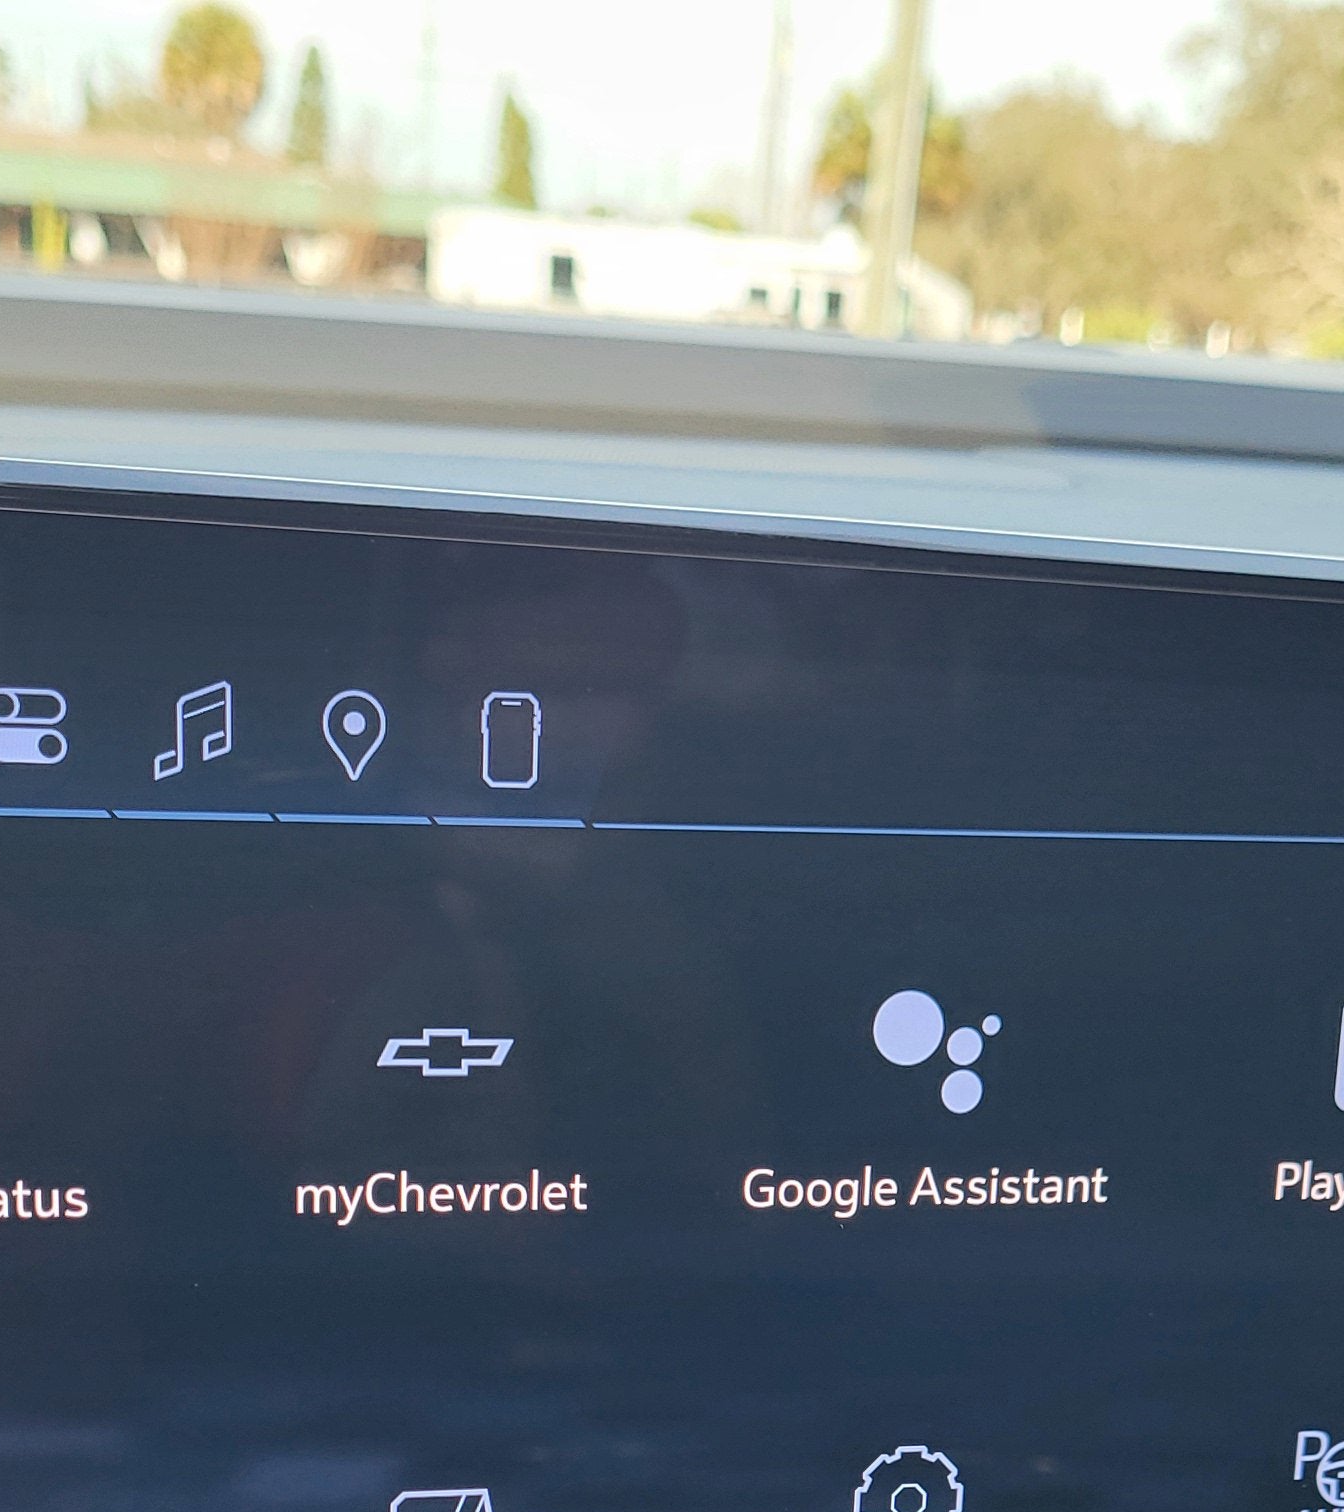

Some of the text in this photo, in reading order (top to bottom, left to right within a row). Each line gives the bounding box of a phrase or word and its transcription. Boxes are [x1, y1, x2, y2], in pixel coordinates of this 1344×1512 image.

[296, 1168, 588, 1226] myChevrolet
[743, 1165, 1109, 1219] Google Assistant
[1293, 1429, 1330, 1481] P
